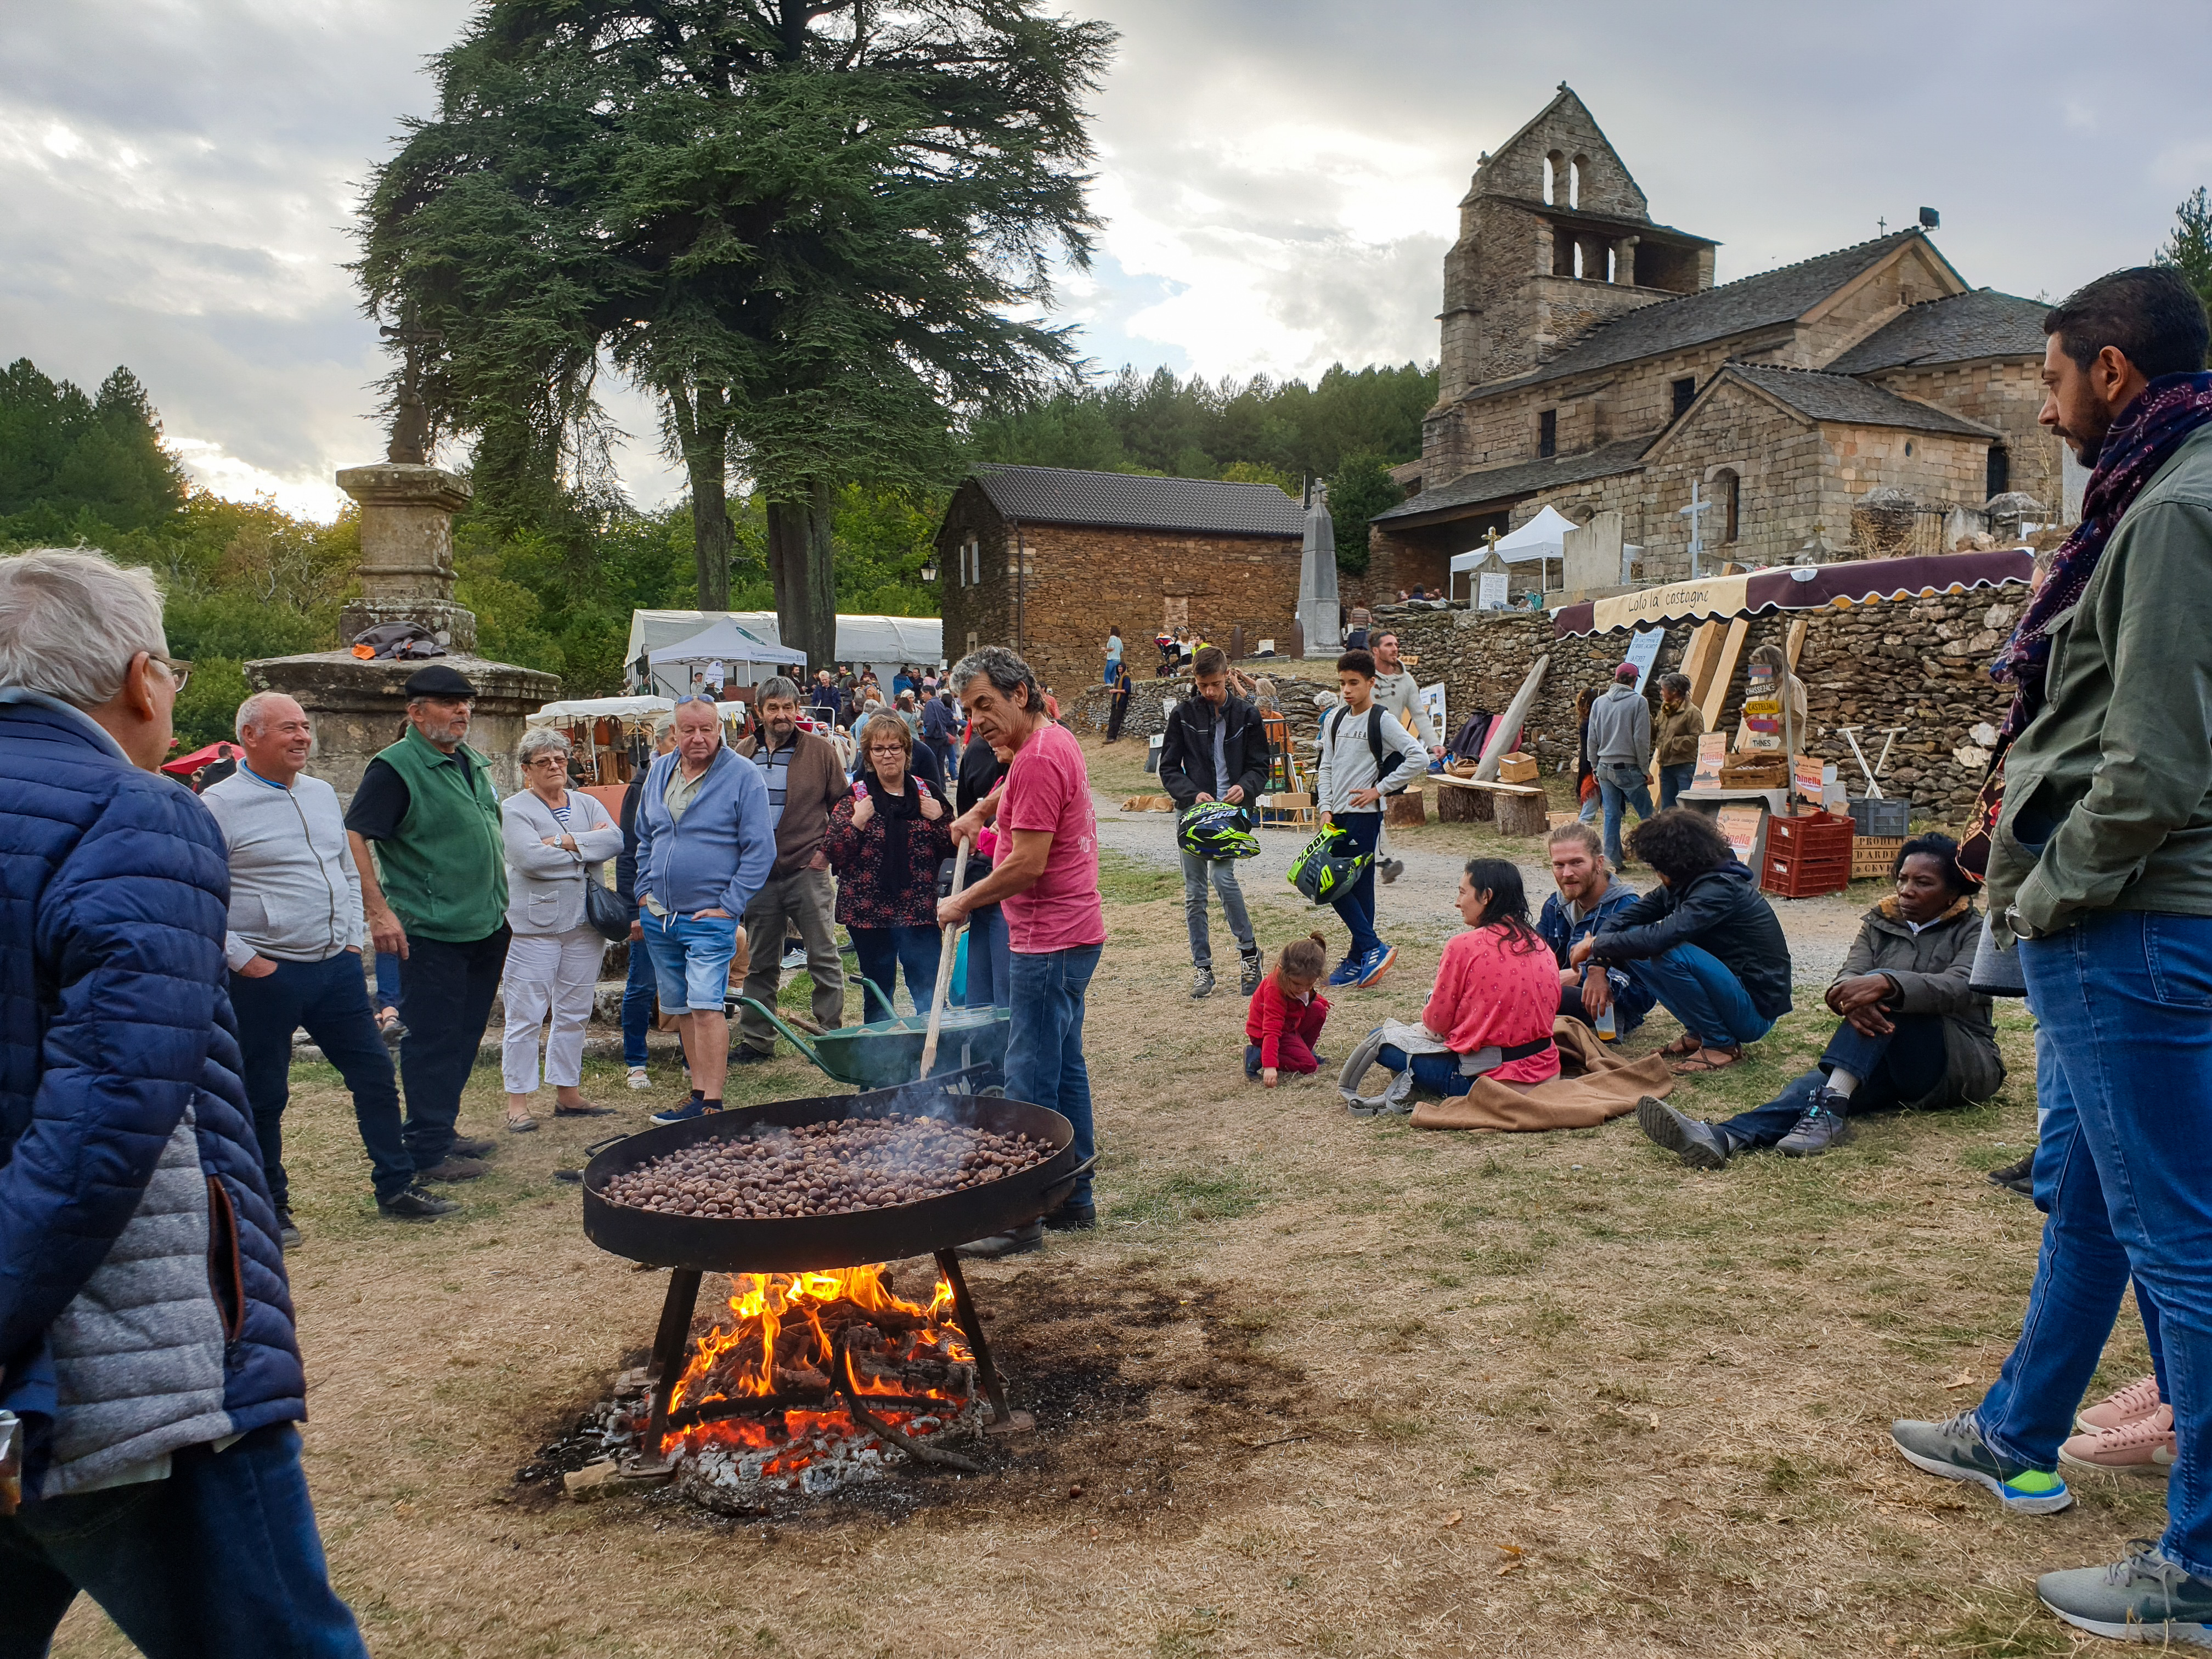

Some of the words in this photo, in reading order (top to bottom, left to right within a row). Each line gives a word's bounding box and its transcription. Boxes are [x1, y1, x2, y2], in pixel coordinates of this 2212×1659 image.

[1628, 594, 1646, 613] Lolo
[1650, 591, 1659, 608] la
[1666, 589, 1709, 608] castagne
[1195, 809, 1239, 825] SHOT
[1297, 833, 1327, 865] 100%
[1857, 850, 1900, 859] D'ARDE
